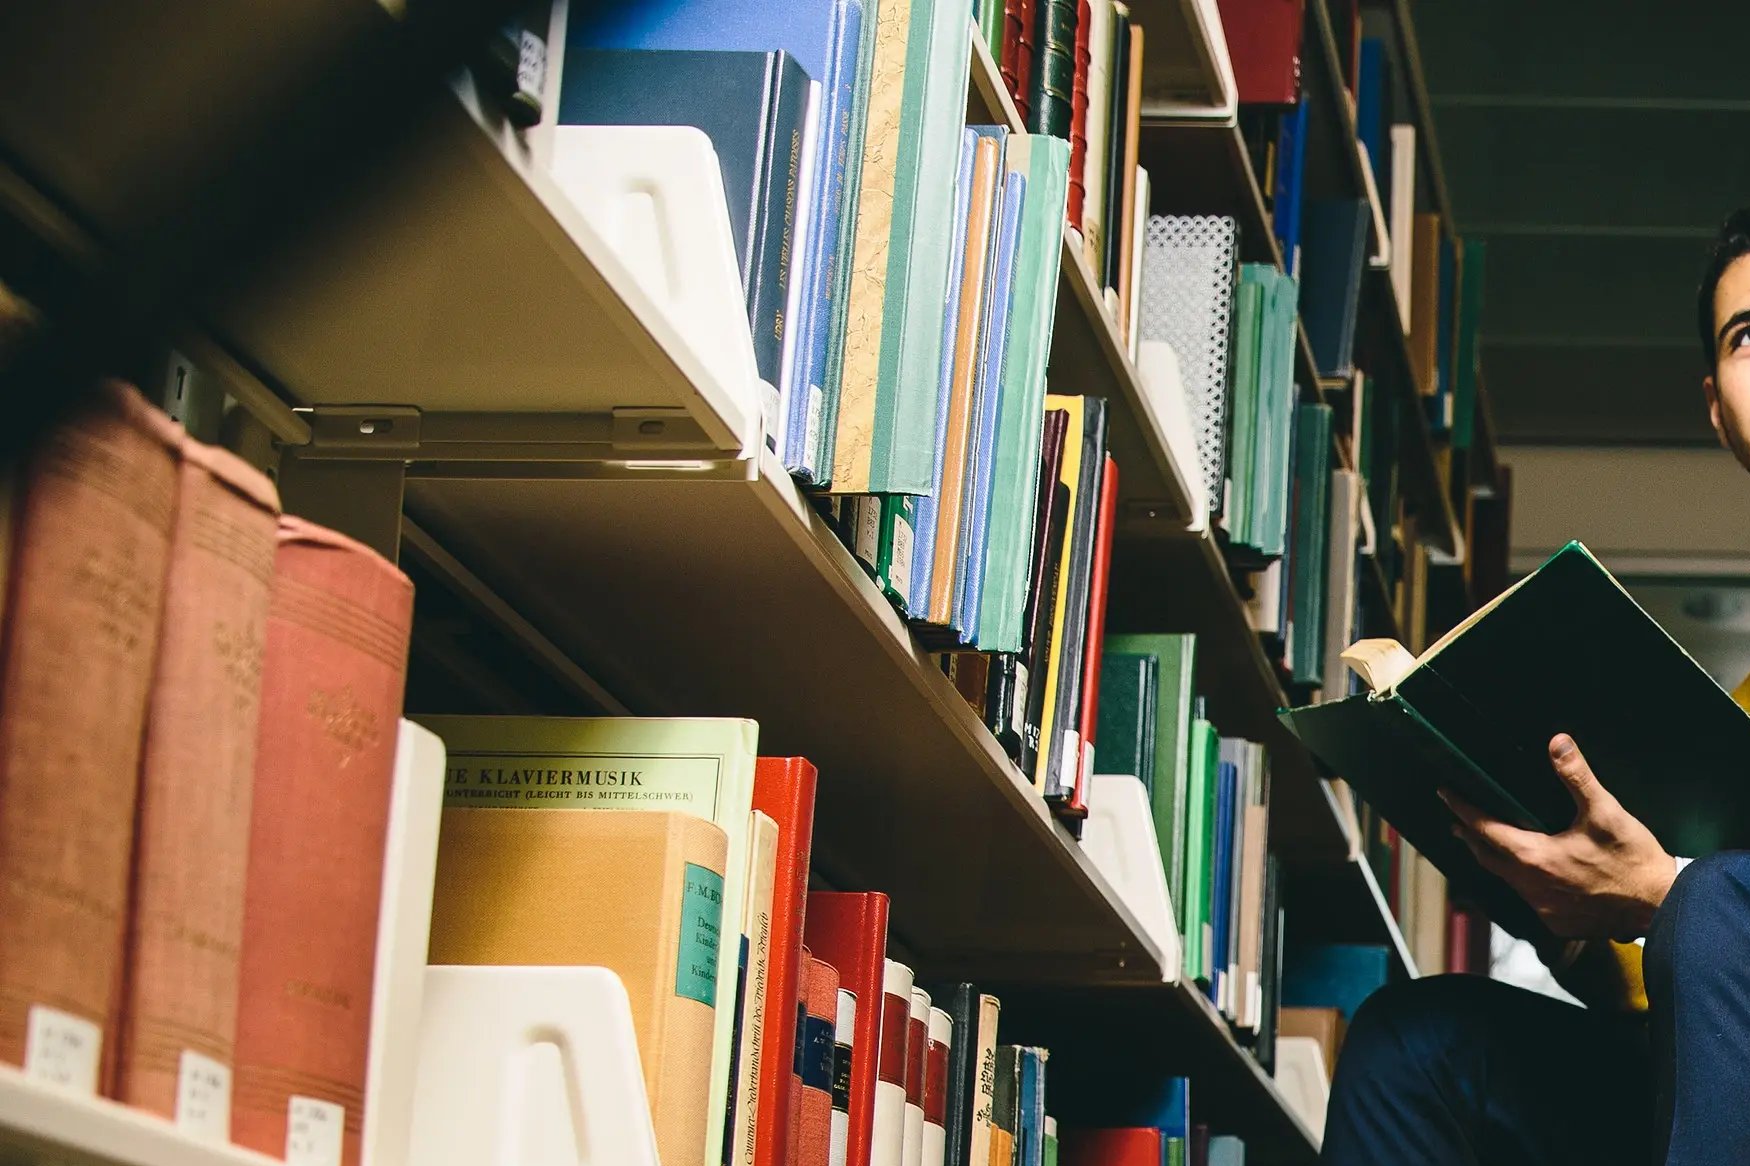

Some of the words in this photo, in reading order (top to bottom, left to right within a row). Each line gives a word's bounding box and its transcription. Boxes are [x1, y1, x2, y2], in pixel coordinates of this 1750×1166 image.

[479, 769, 644, 786] KLAVIERMUSIK
[525, 790, 571, 801] (LEICHT
[576, 790, 594, 800] BIS
[599, 791, 694, 802] MITTELSCHWER)
